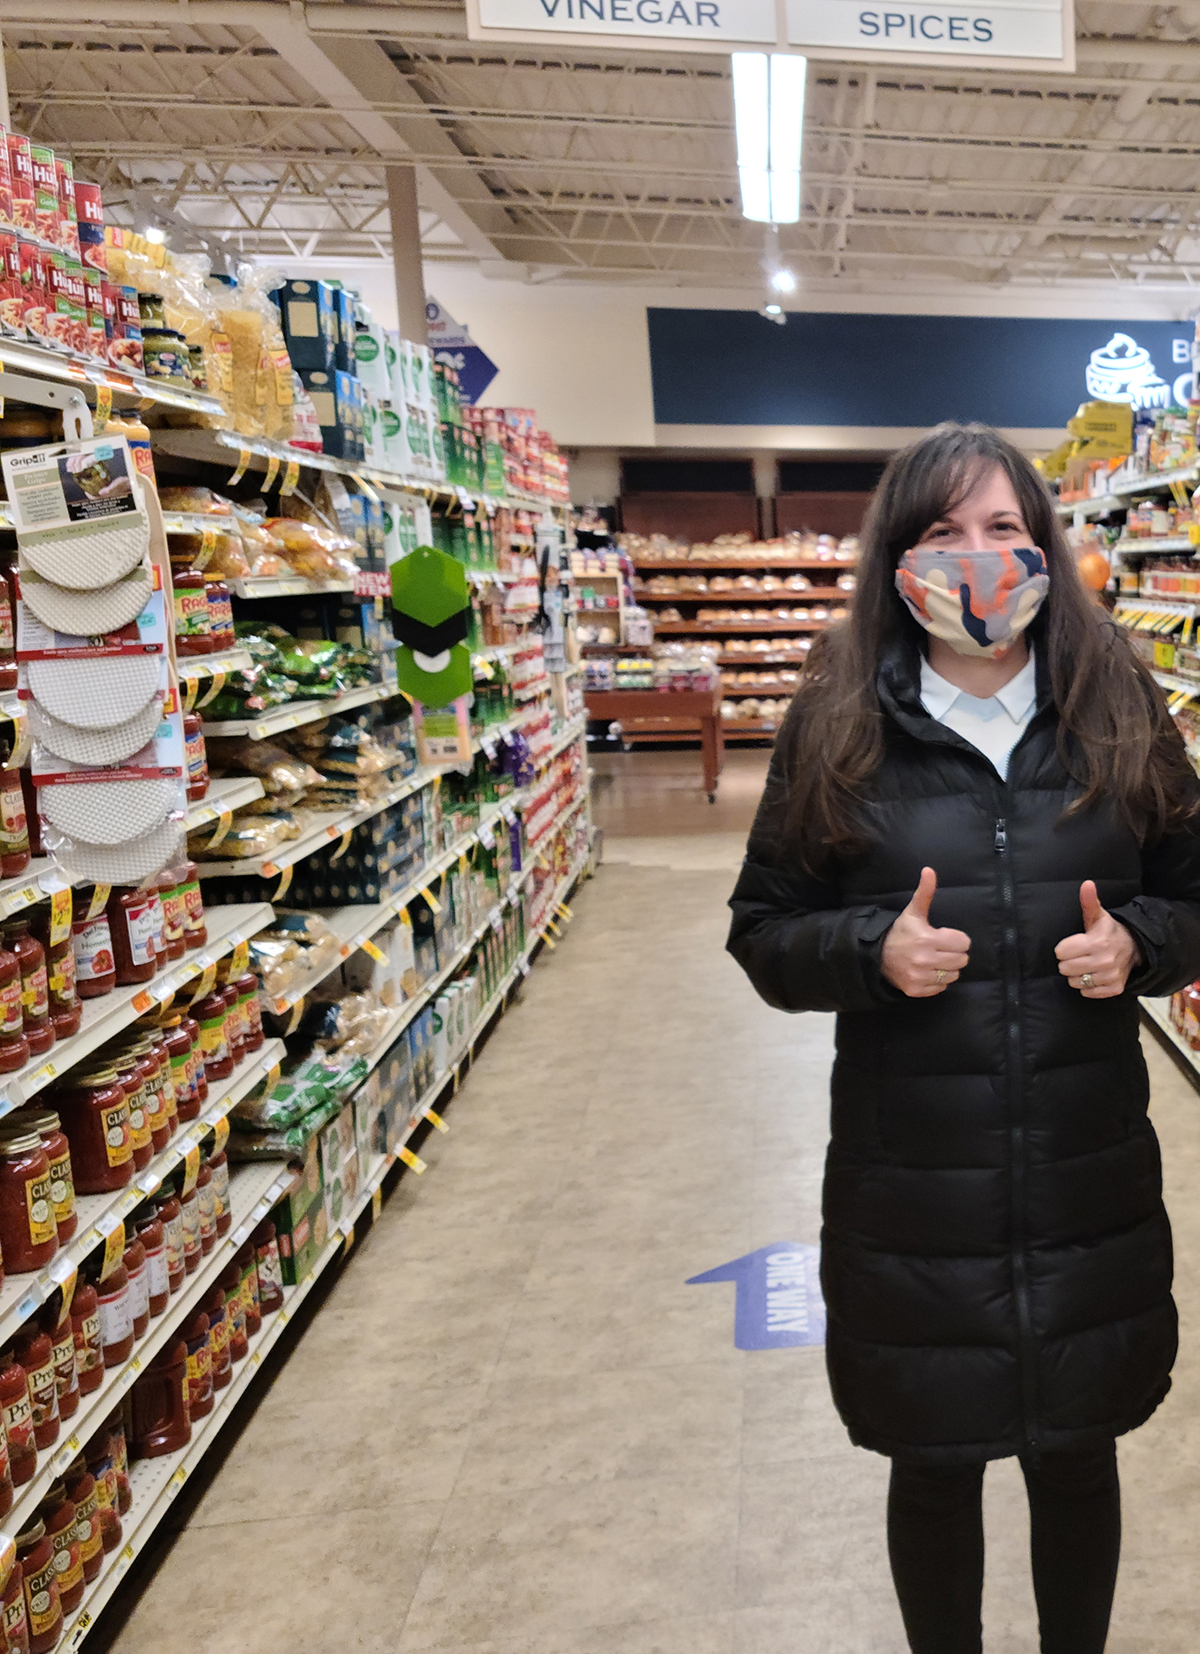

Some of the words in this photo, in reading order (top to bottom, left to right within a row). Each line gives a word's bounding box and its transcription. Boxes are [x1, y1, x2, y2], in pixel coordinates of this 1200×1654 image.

[541, 0, 721, 28] VINEGAR
[859, 11, 994, 43] SPICES
[353, 585, 392, 597] ITEM
[354, 572, 391, 586] NEW
[765, 1251, 806, 1288] ONE
[766, 1287, 809, 1332] WAY
